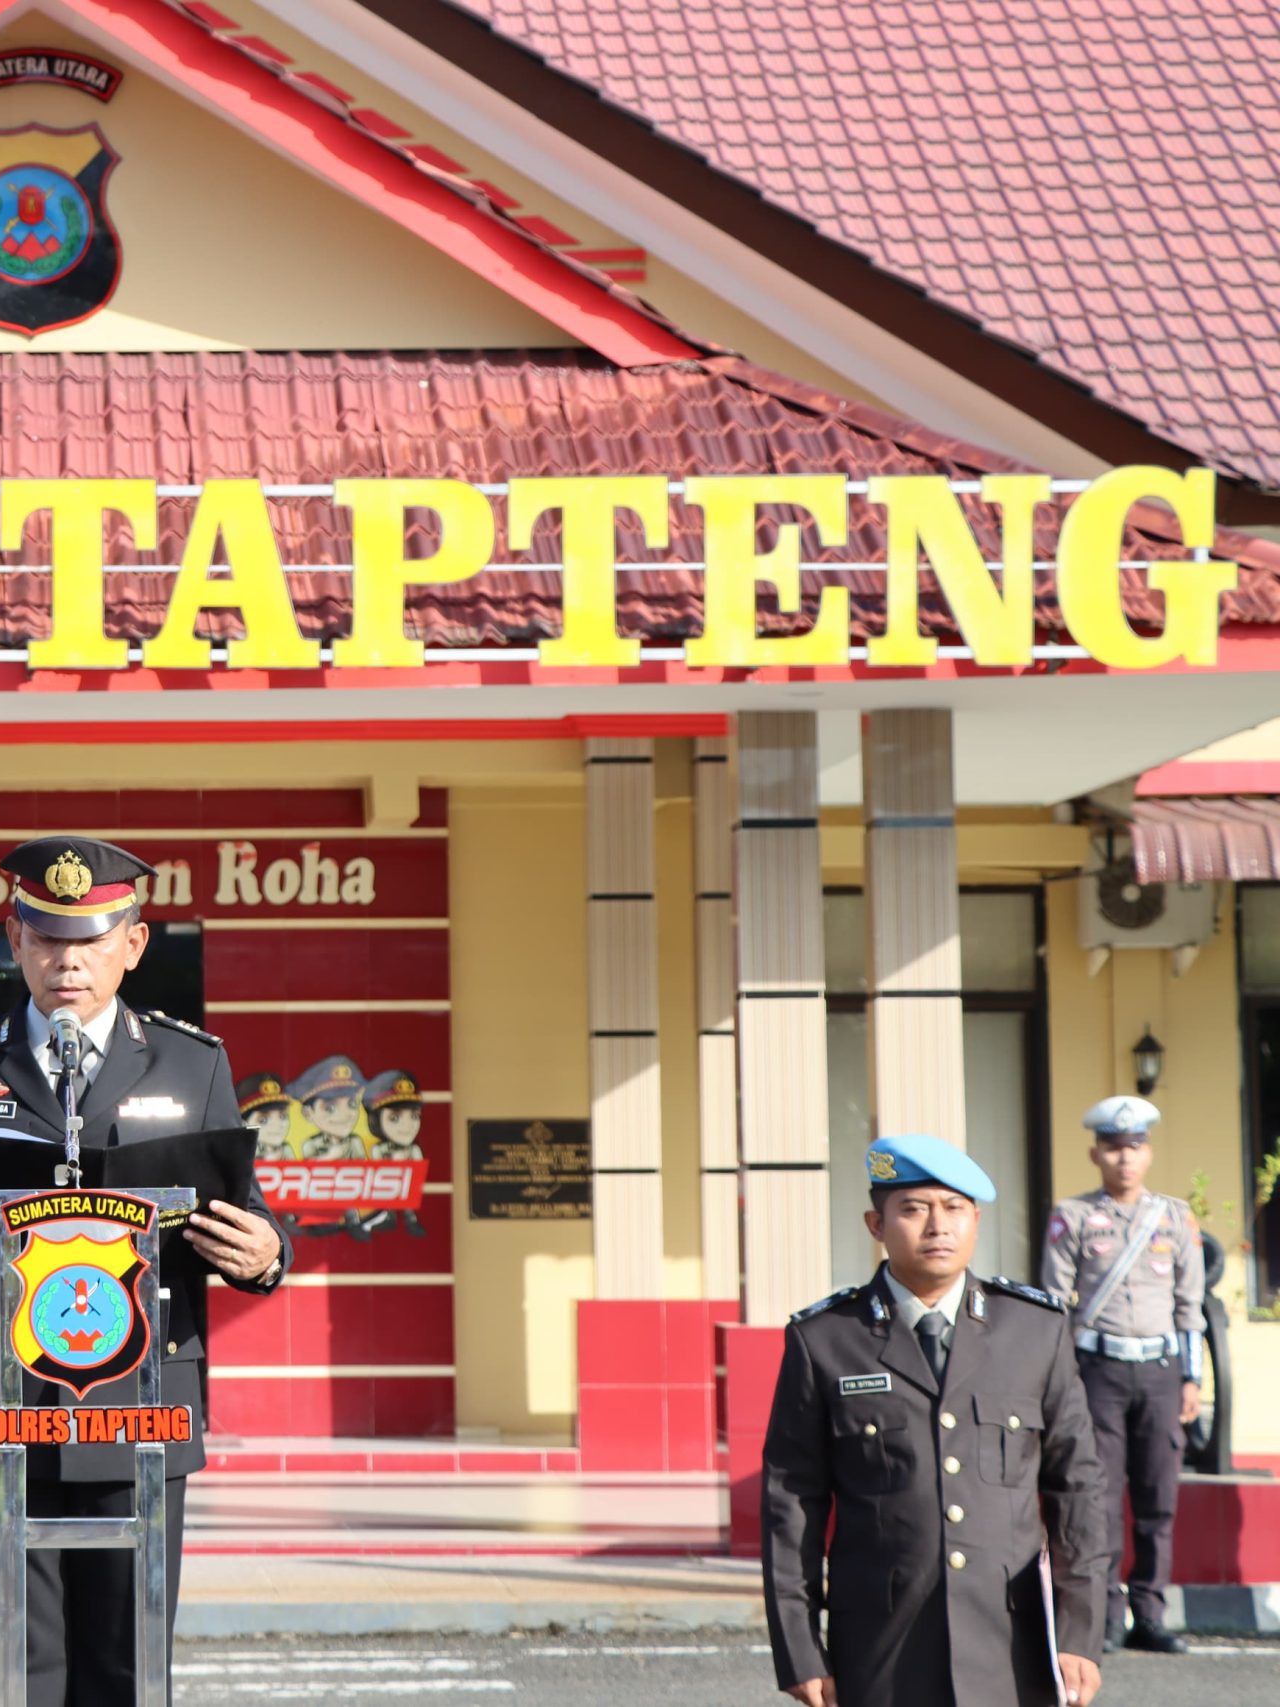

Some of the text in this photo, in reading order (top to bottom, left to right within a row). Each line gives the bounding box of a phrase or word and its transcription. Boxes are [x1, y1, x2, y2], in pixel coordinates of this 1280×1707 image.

[53, 57, 110, 90] UTARA
[0, 465, 1238, 671] TAPTENG
[214, 841, 376, 906] Roha
[256, 1167, 413, 1201] PRESISI
[8, 1196, 91, 1226] SUMATERA
[95, 1197, 147, 1225] UTARA
[73, 1406, 191, 1443] TAPTENG
